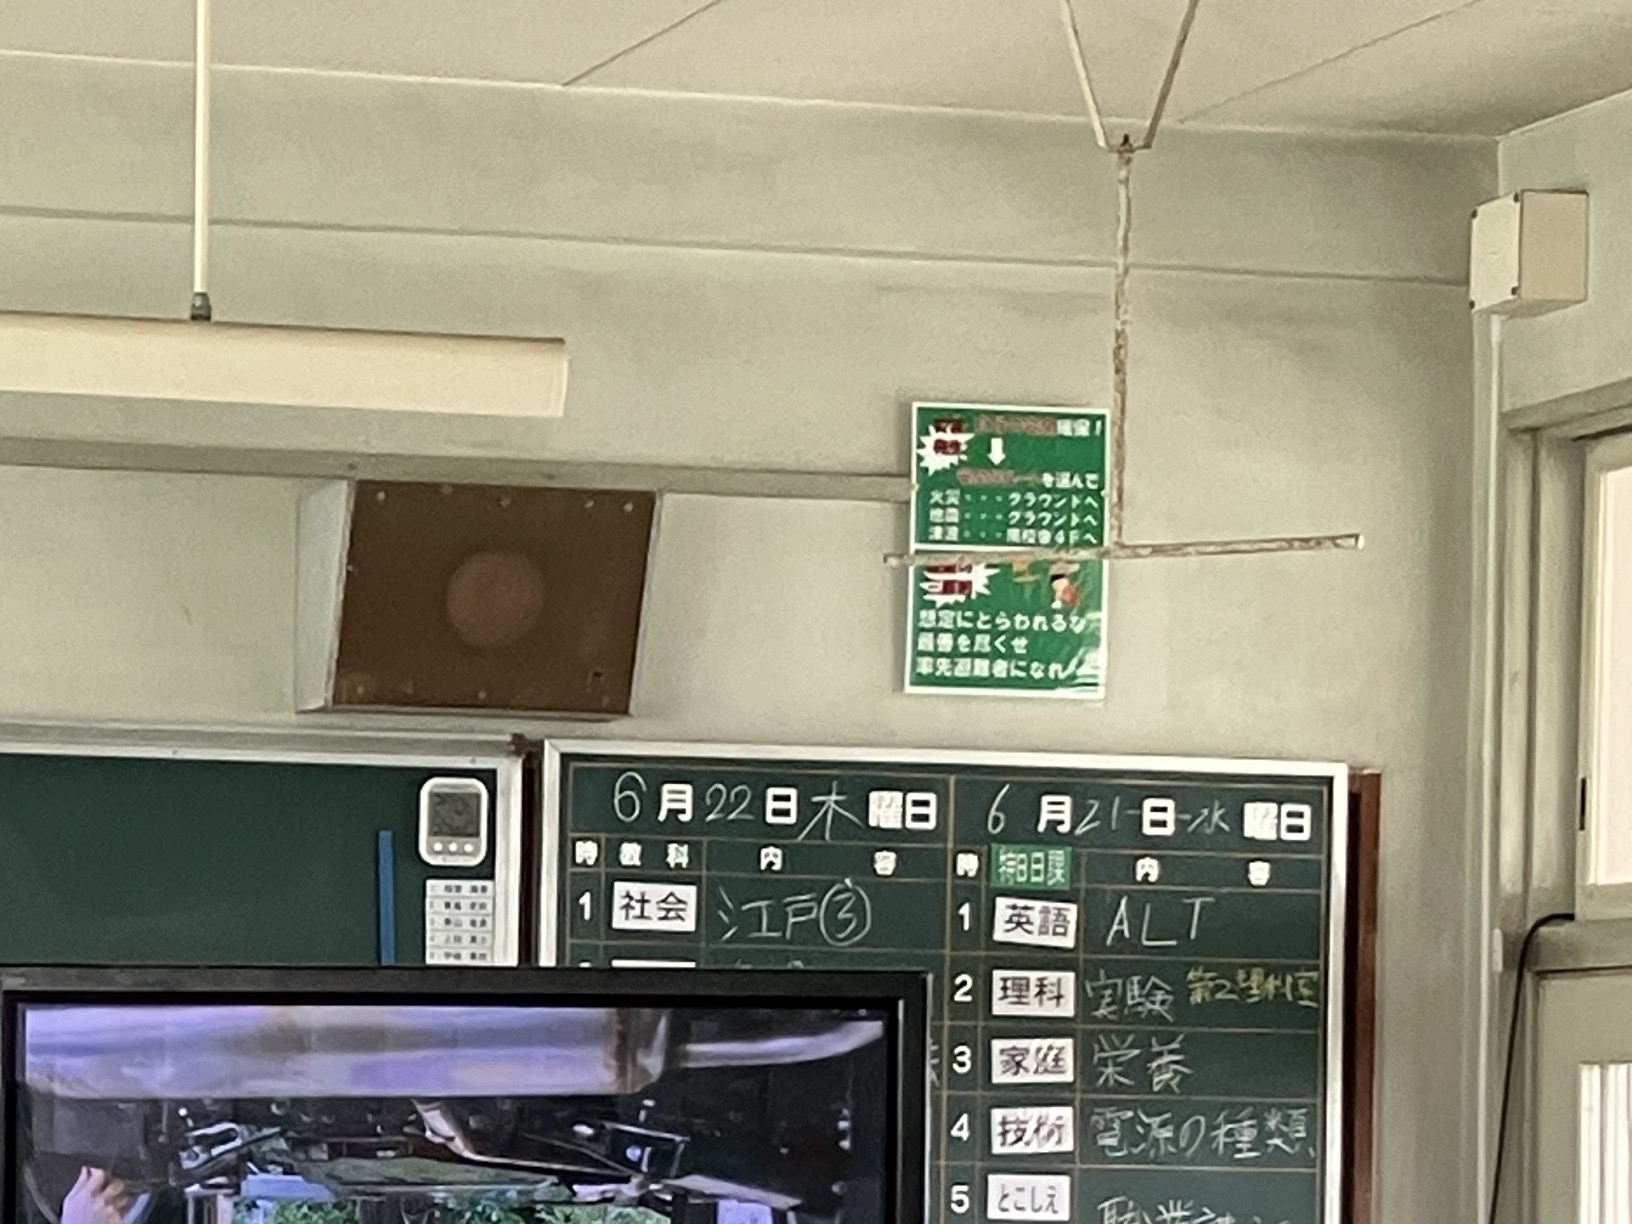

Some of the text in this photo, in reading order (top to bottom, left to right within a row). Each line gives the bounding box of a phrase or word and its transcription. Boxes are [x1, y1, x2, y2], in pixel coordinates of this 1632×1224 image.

[577, 891, 689, 923] 1 社会
[957, 901, 1072, 938] 1 英語
[1106, 895, 1216, 947] ALT
[953, 974, 1066, 1007] 2 理科
[1084, 968, 1175, 1022] 実験
[952, 1046, 1067, 1077] 3 家庭
[1091, 1033, 1194, 1095] 栄養
[950, 1113, 1065, 1149] 4 技術
[951, 1183, 1059, 1215] 5 とこしえ
